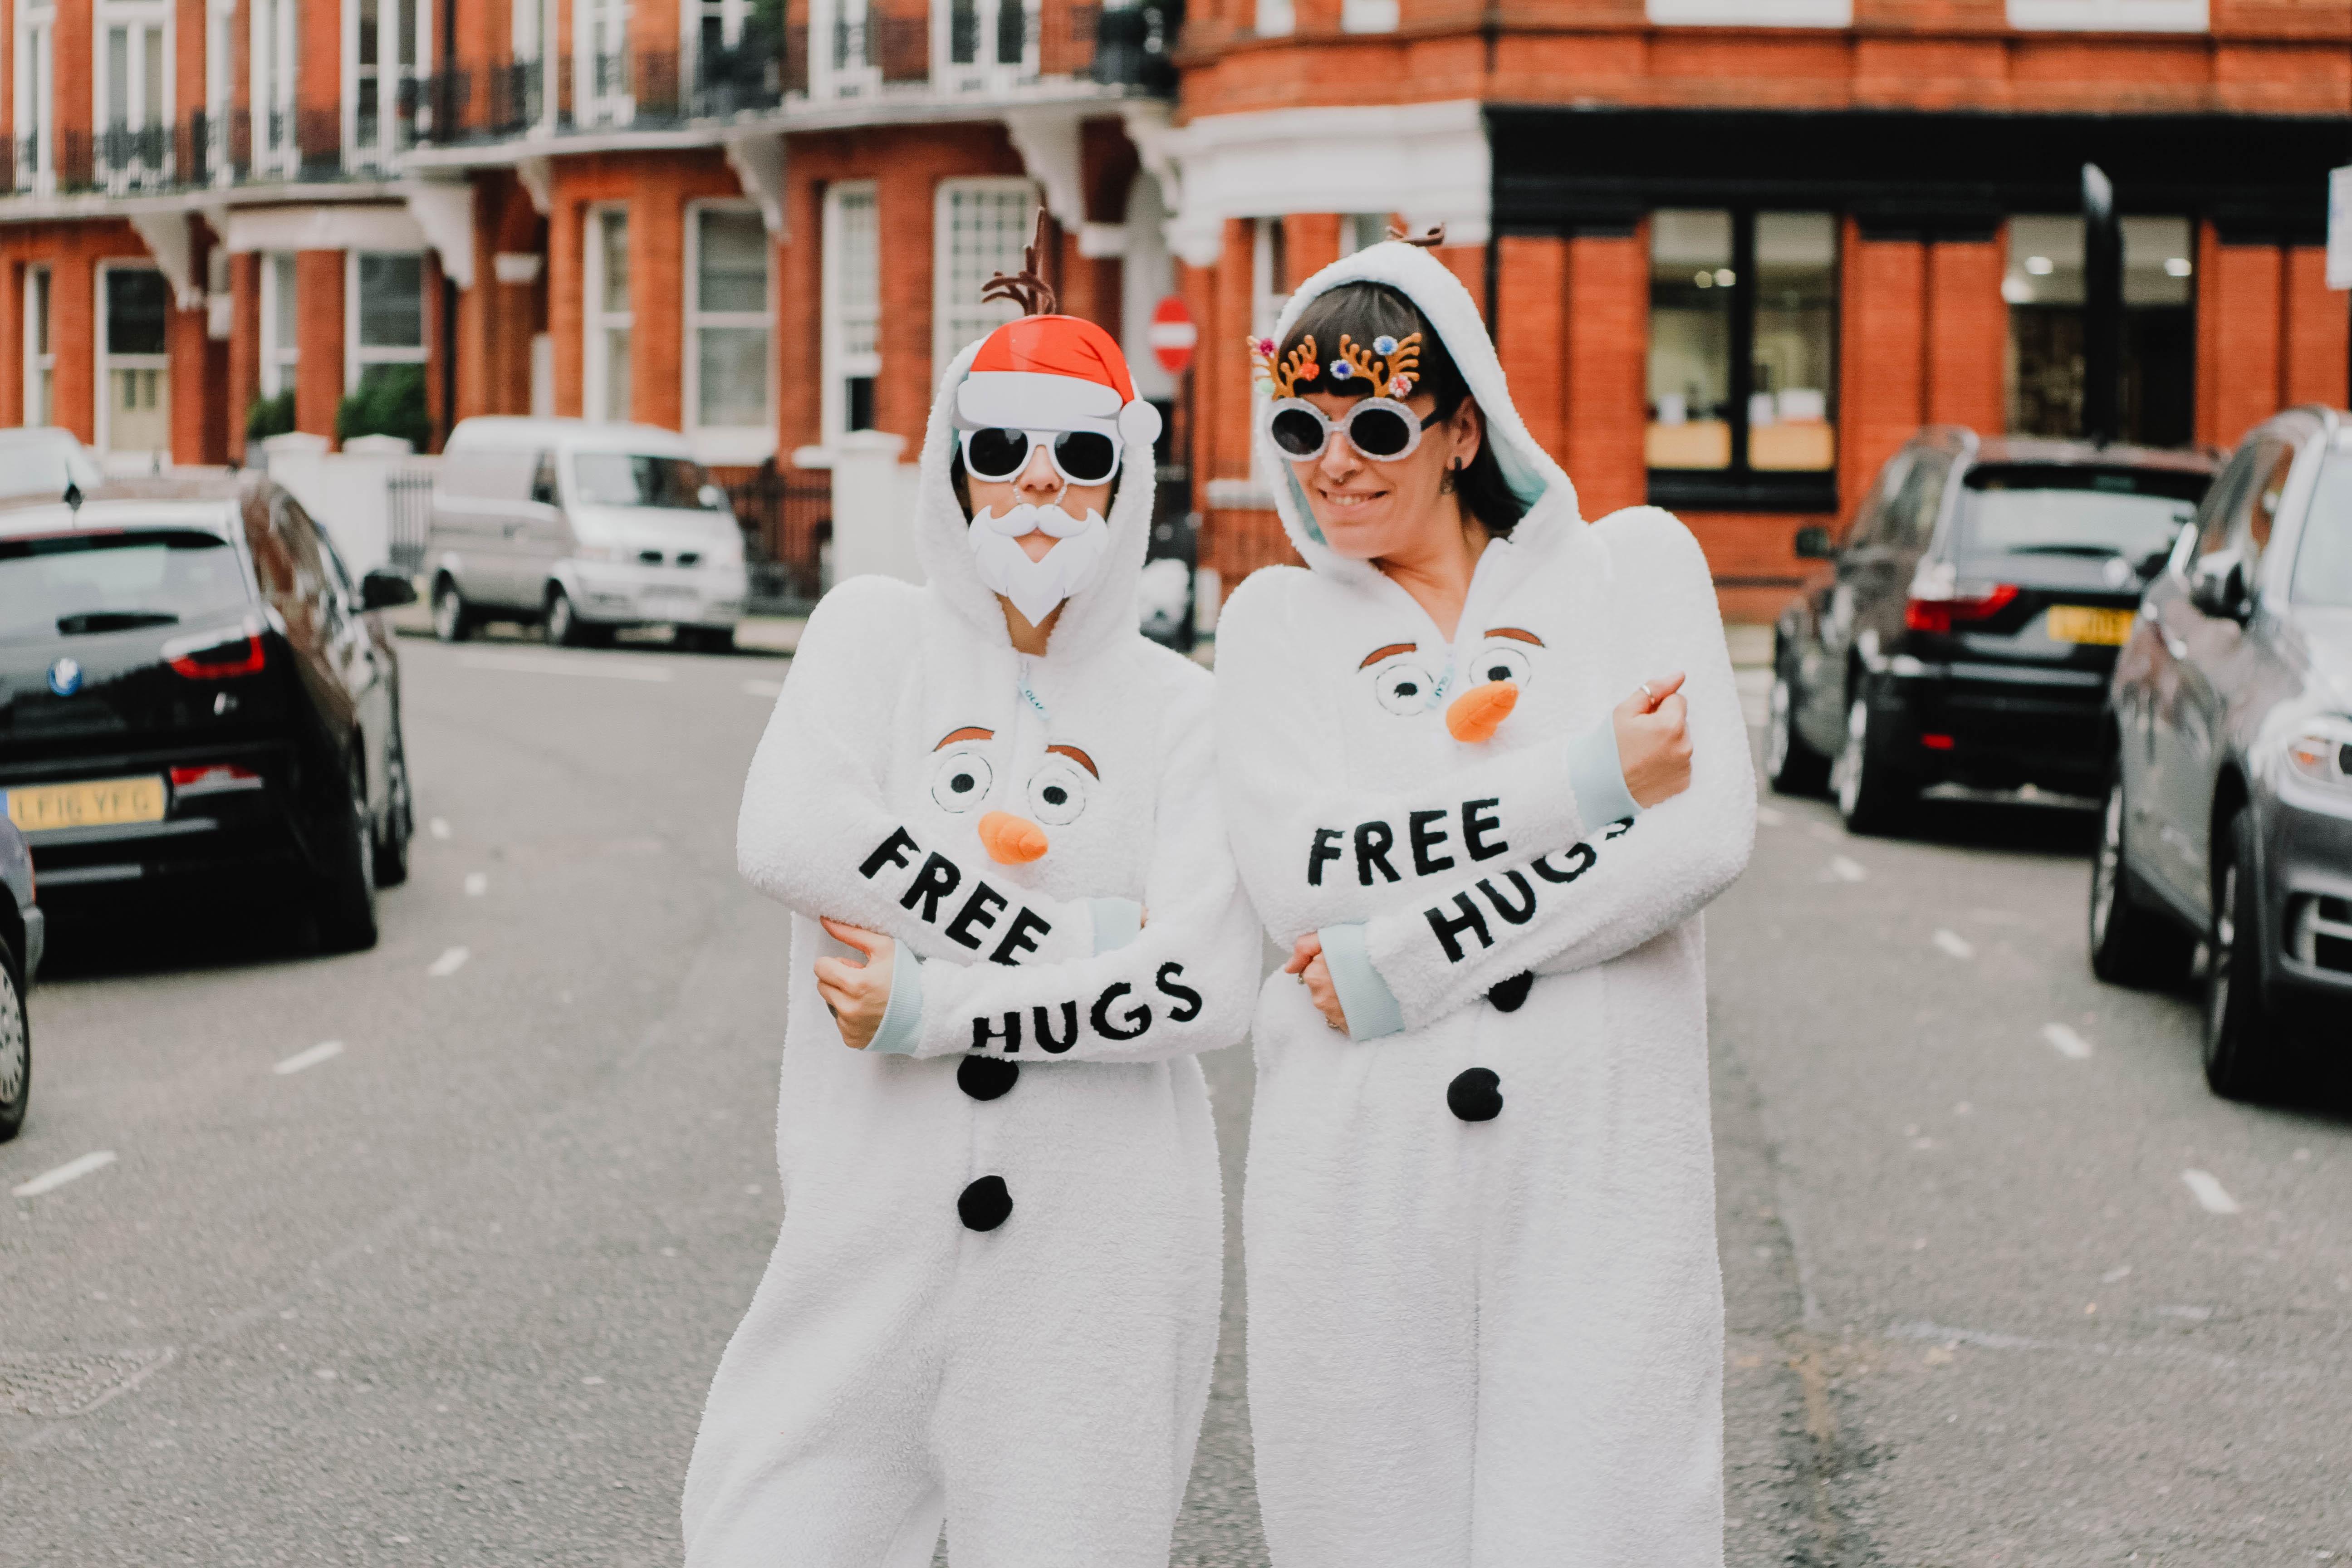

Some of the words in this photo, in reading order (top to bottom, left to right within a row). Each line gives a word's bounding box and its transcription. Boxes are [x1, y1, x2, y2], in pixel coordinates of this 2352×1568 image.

[1308, 798, 1509, 886] FREE
[859, 826, 1052, 966] FREE
[971, 962, 1202, 1054] HUGS
